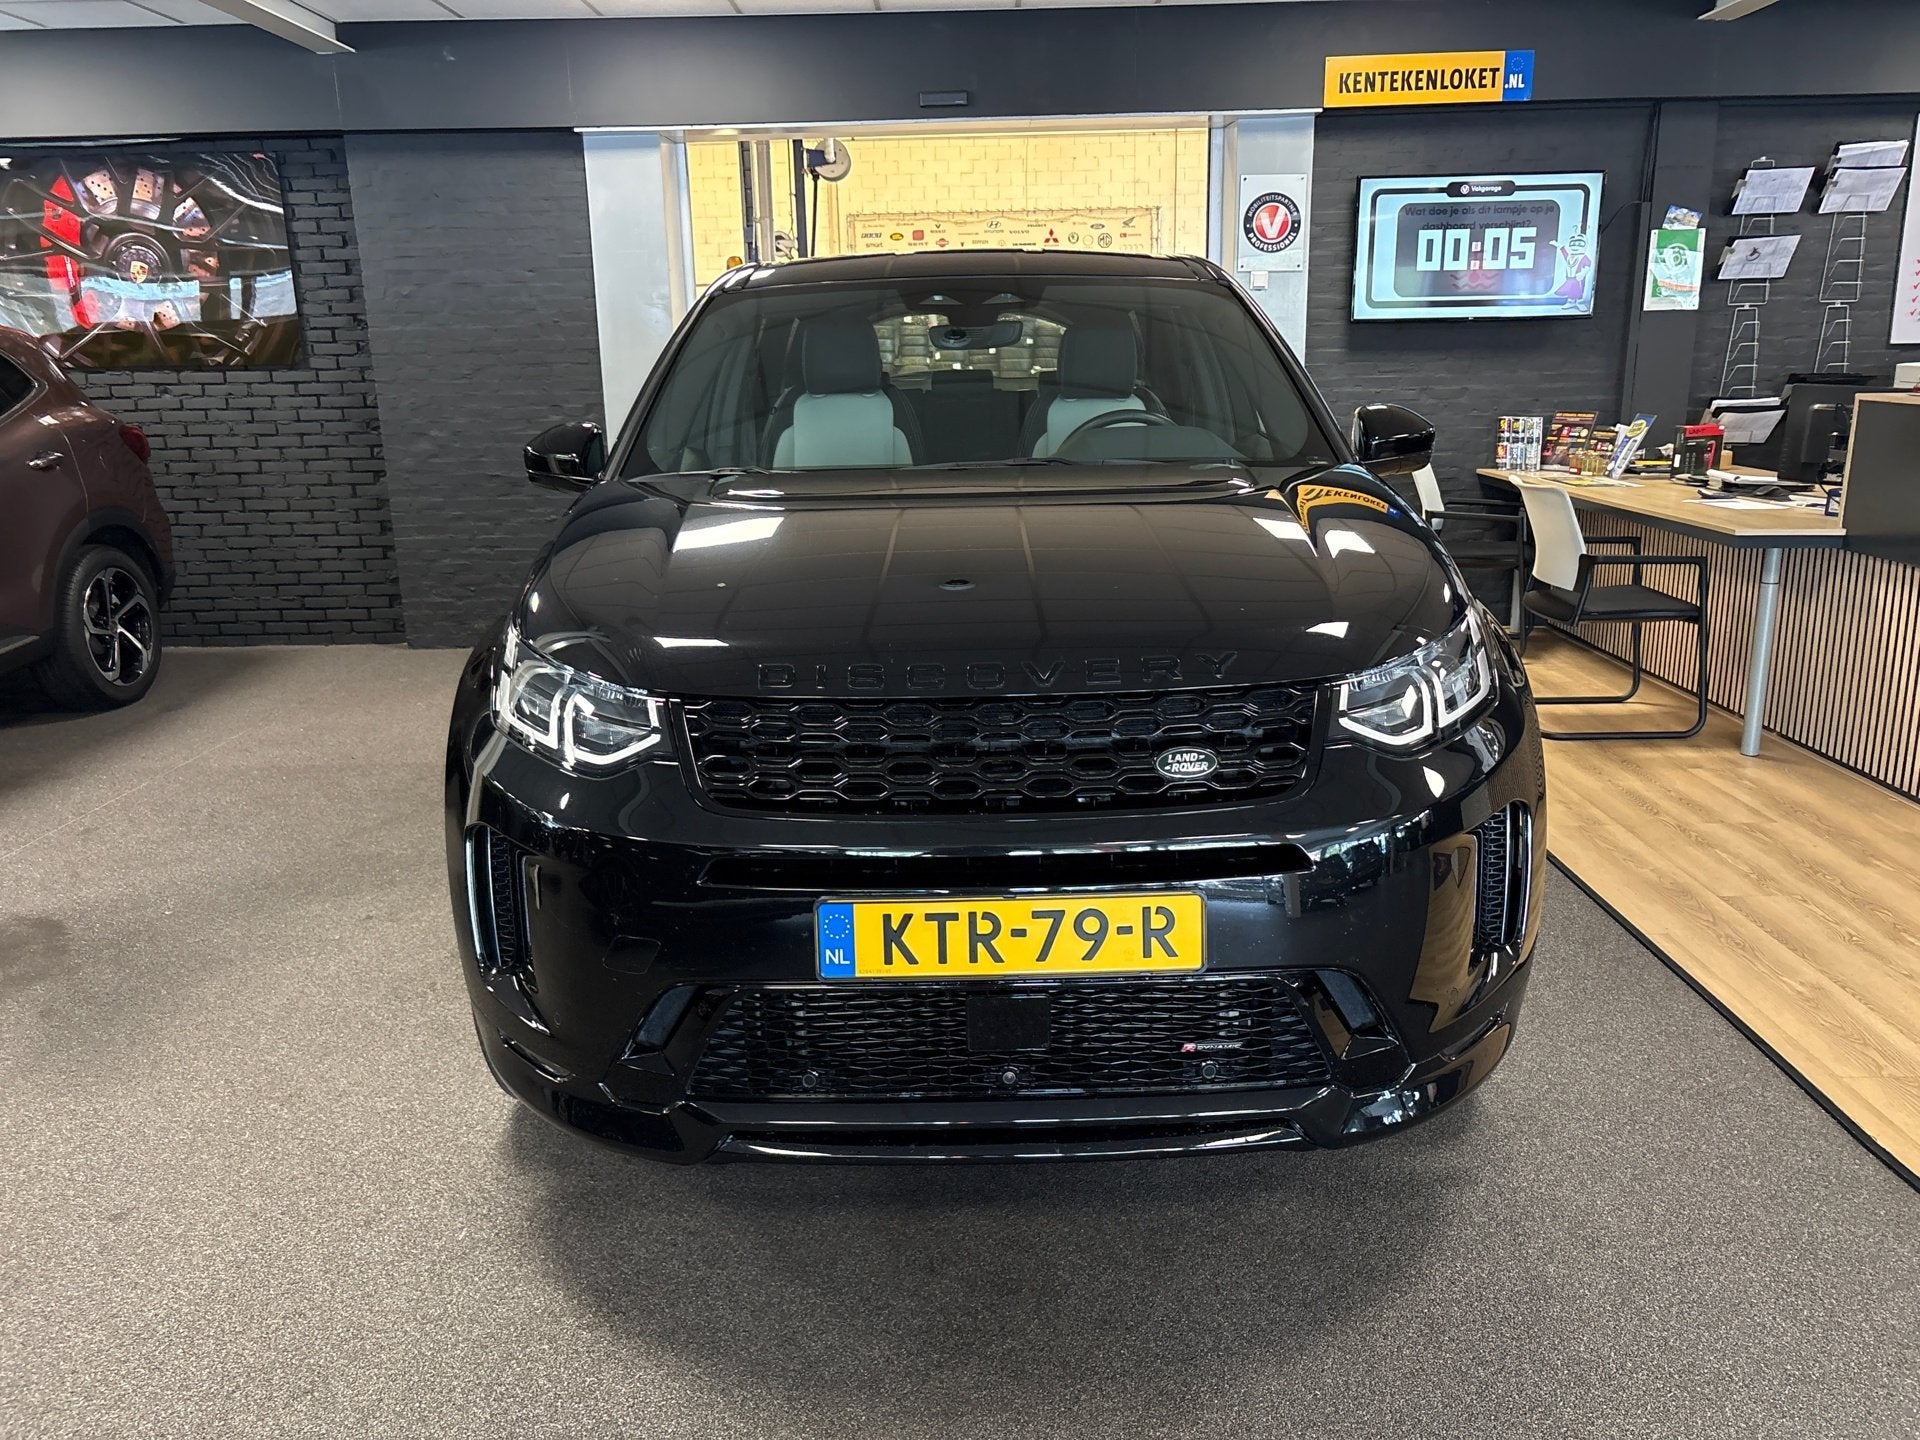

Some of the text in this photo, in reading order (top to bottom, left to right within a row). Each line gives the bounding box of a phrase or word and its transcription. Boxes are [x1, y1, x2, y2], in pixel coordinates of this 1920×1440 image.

[1339, 67, 1500, 94] KENTEKENLOKET
[1471, 185, 1502, 194] Vakgarage
[1247, 194, 1298, 217] MOBILITEITSPARTNER
[1404, 203, 1555, 218] Wat doe je als dit lampje op je
[1422, 220, 1476, 230] dashboard
[1247, 232, 1297, 252] PROFESSIONAL
[1416, 226, 1537, 272] 00:05
[755, 650, 1238, 690] DISCOVERY
[1167, 753, 1198, 763] LAND
[1171, 762, 1208, 772] ROVER
[882, 905, 1179, 966] KTR-79-R
[825, 948, 850, 965] NL
